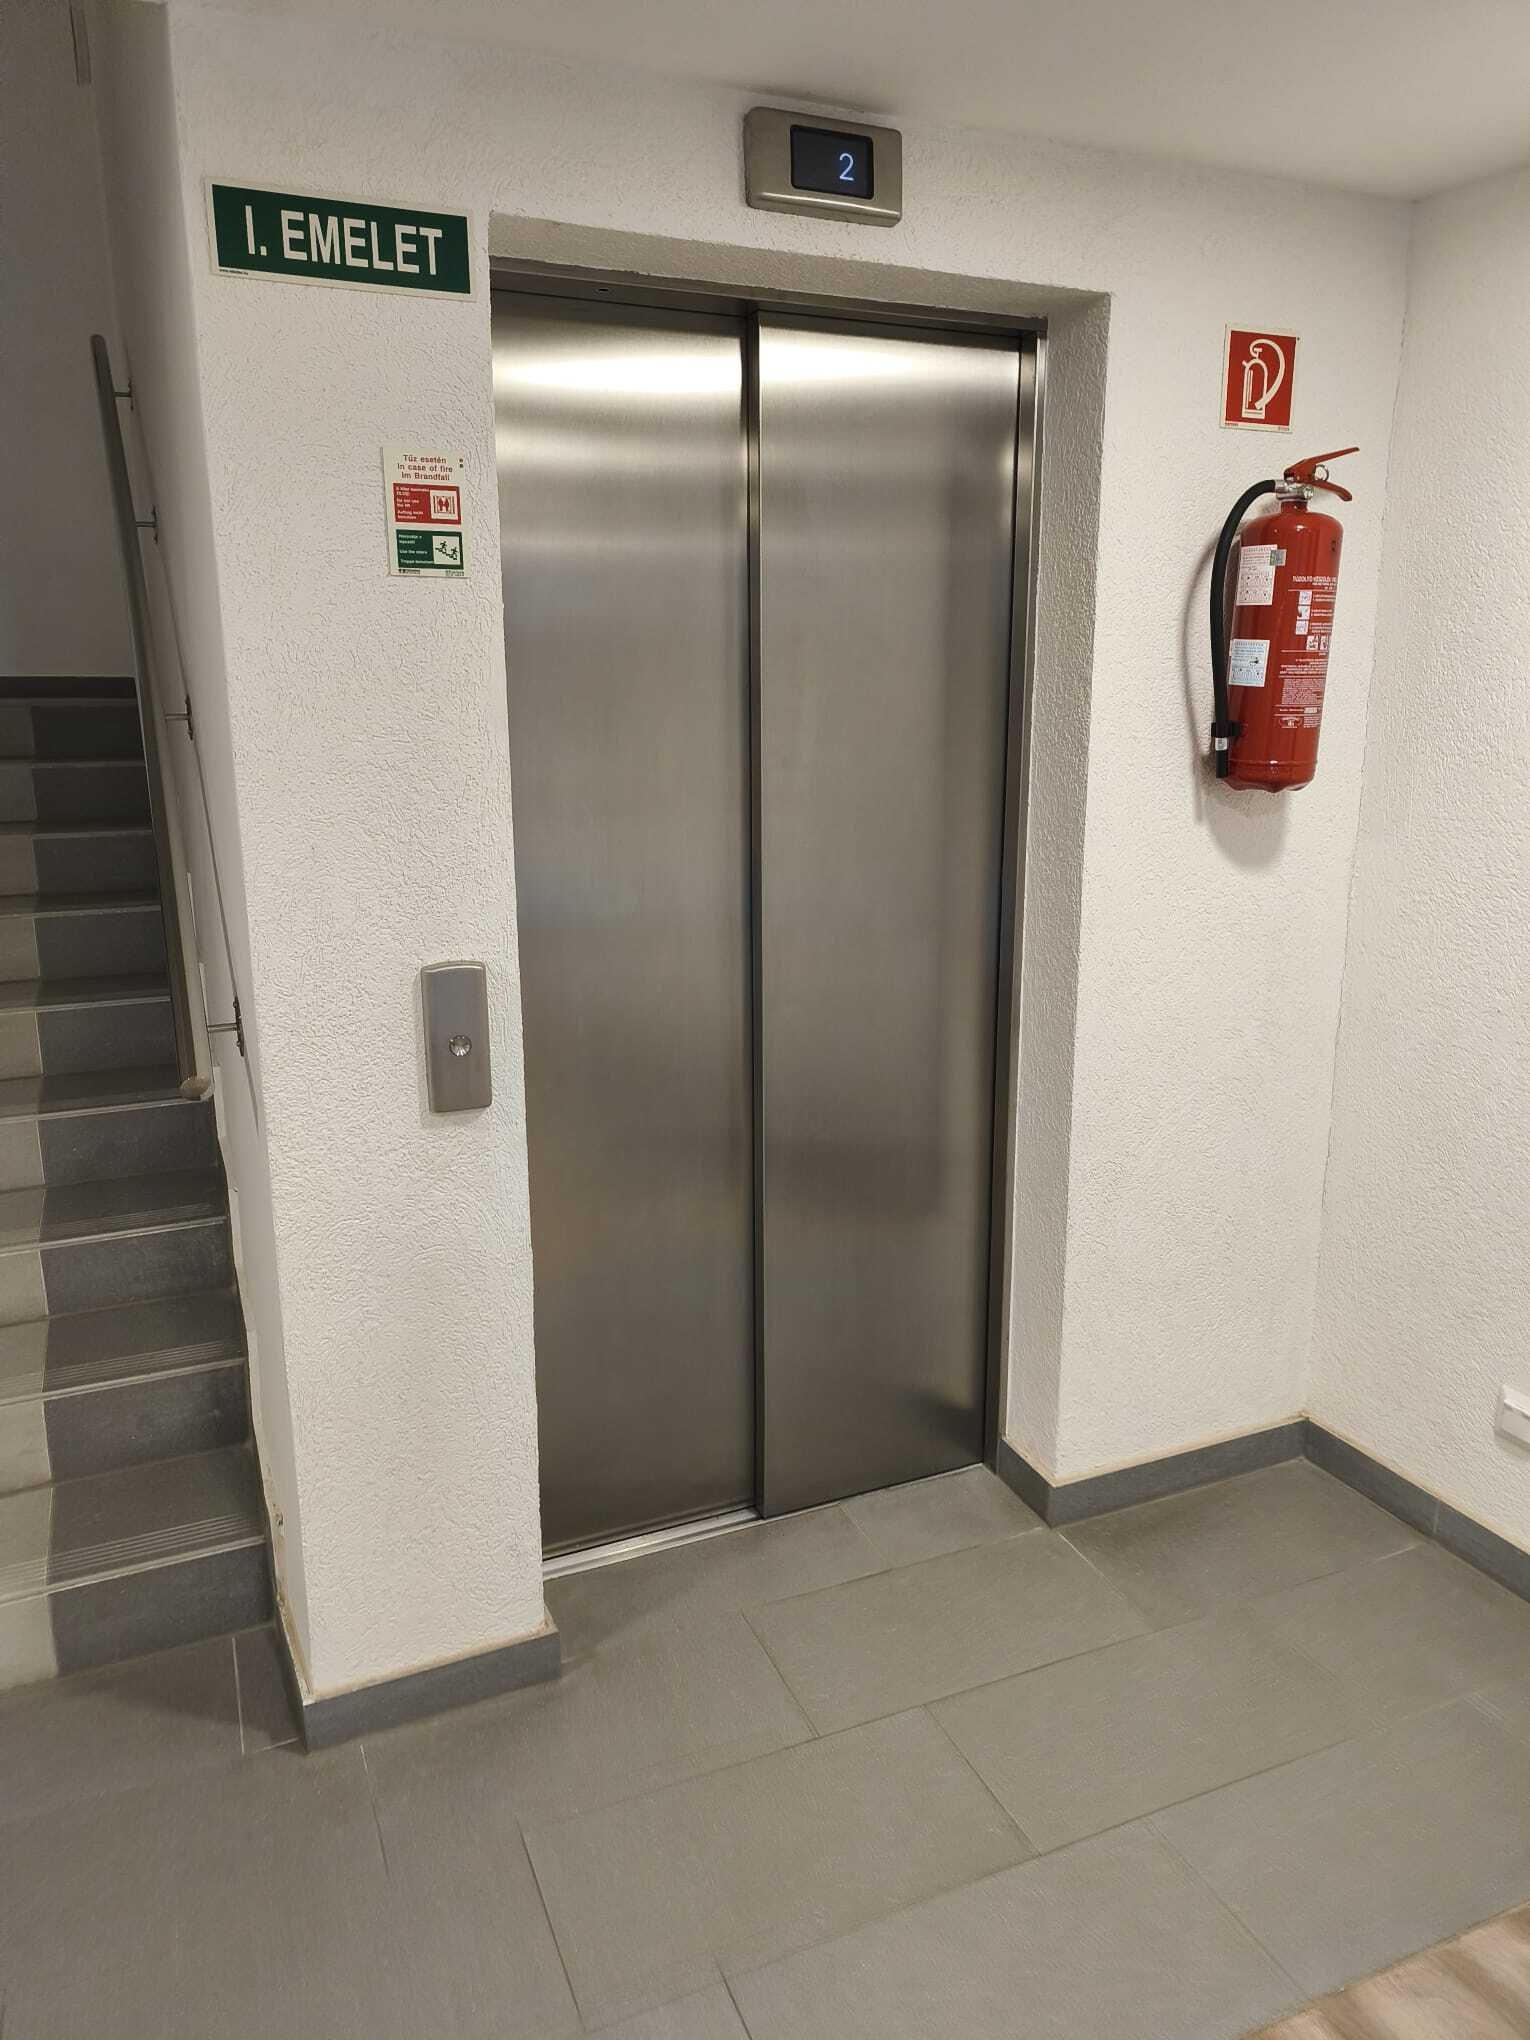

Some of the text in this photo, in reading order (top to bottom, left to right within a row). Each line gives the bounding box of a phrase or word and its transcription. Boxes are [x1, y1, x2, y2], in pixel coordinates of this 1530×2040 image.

[839, 153, 854, 181] 2
[245, 205, 443, 276] I. EMELET
[420, 456, 447, 464] esetén
[440, 465, 453, 473] fire
[414, 472, 450, 480] Brandfall
